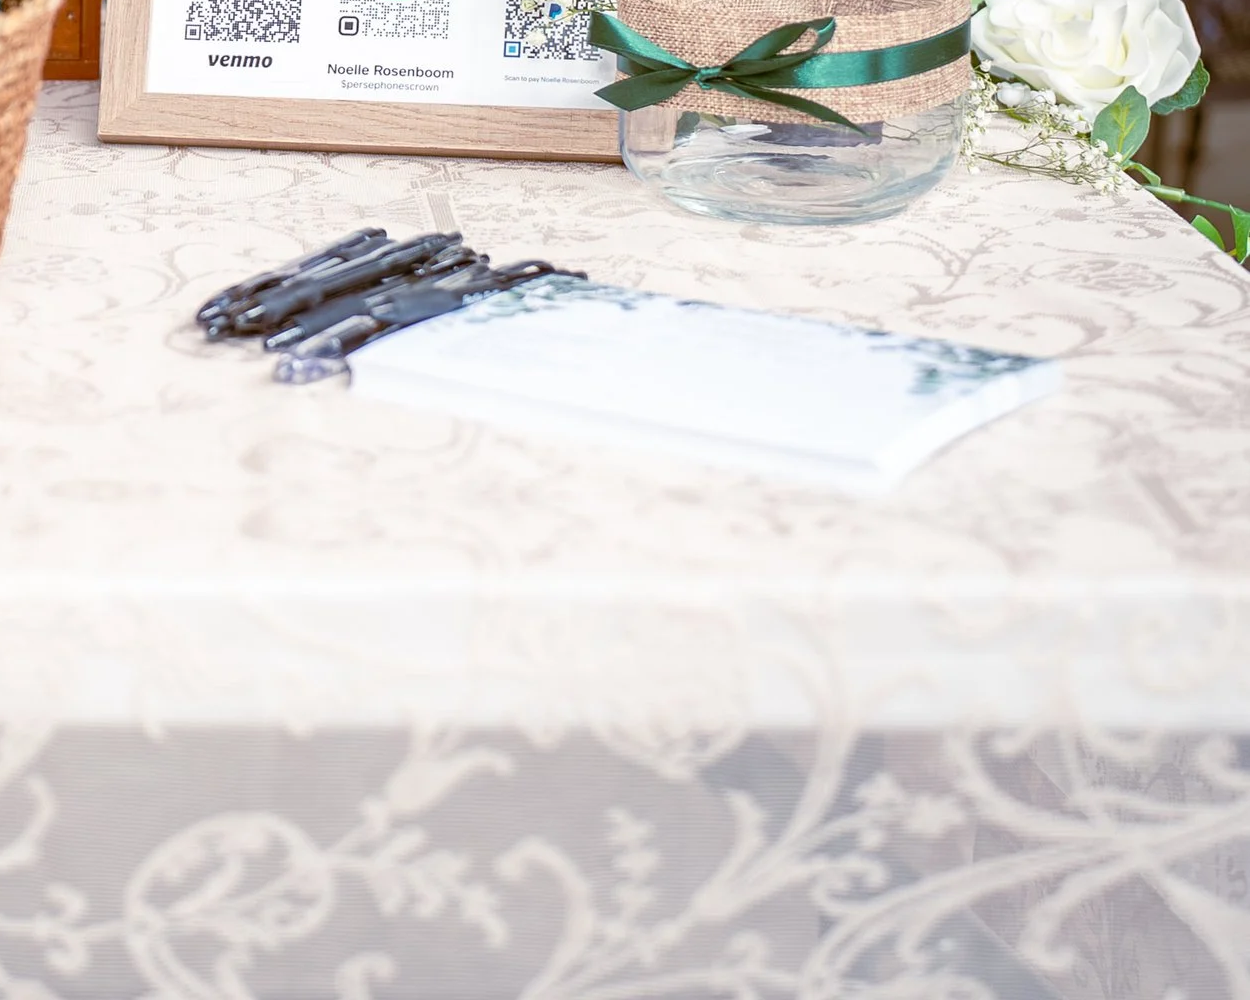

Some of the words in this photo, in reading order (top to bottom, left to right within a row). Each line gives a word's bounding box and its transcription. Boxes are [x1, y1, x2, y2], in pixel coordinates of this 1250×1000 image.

[208, 54, 273, 69] venmo
[327, 63, 369, 76] Noelle
[374, 65, 454, 79] Rosenboom
[504, 74, 520, 82] Scan
[528, 76, 540, 84] pay
